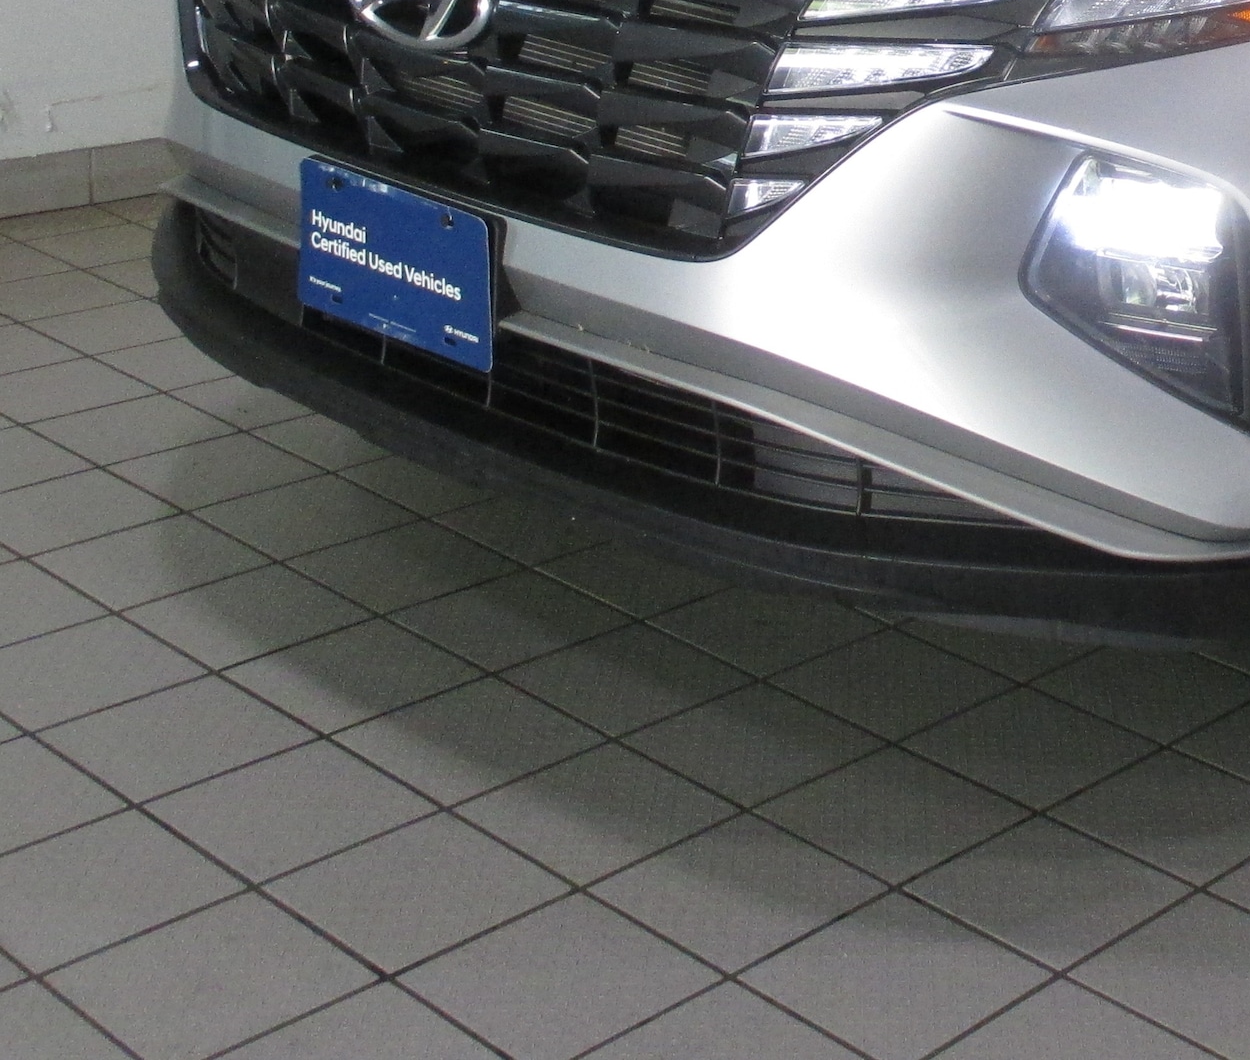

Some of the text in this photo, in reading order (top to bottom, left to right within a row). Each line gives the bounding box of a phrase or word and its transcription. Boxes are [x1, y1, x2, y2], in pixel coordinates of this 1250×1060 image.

[311, 208, 367, 244] Hyundai
[310, 231, 463, 302] Certified Used Vehicles
[453, 328, 479, 344] HYUNDAI
